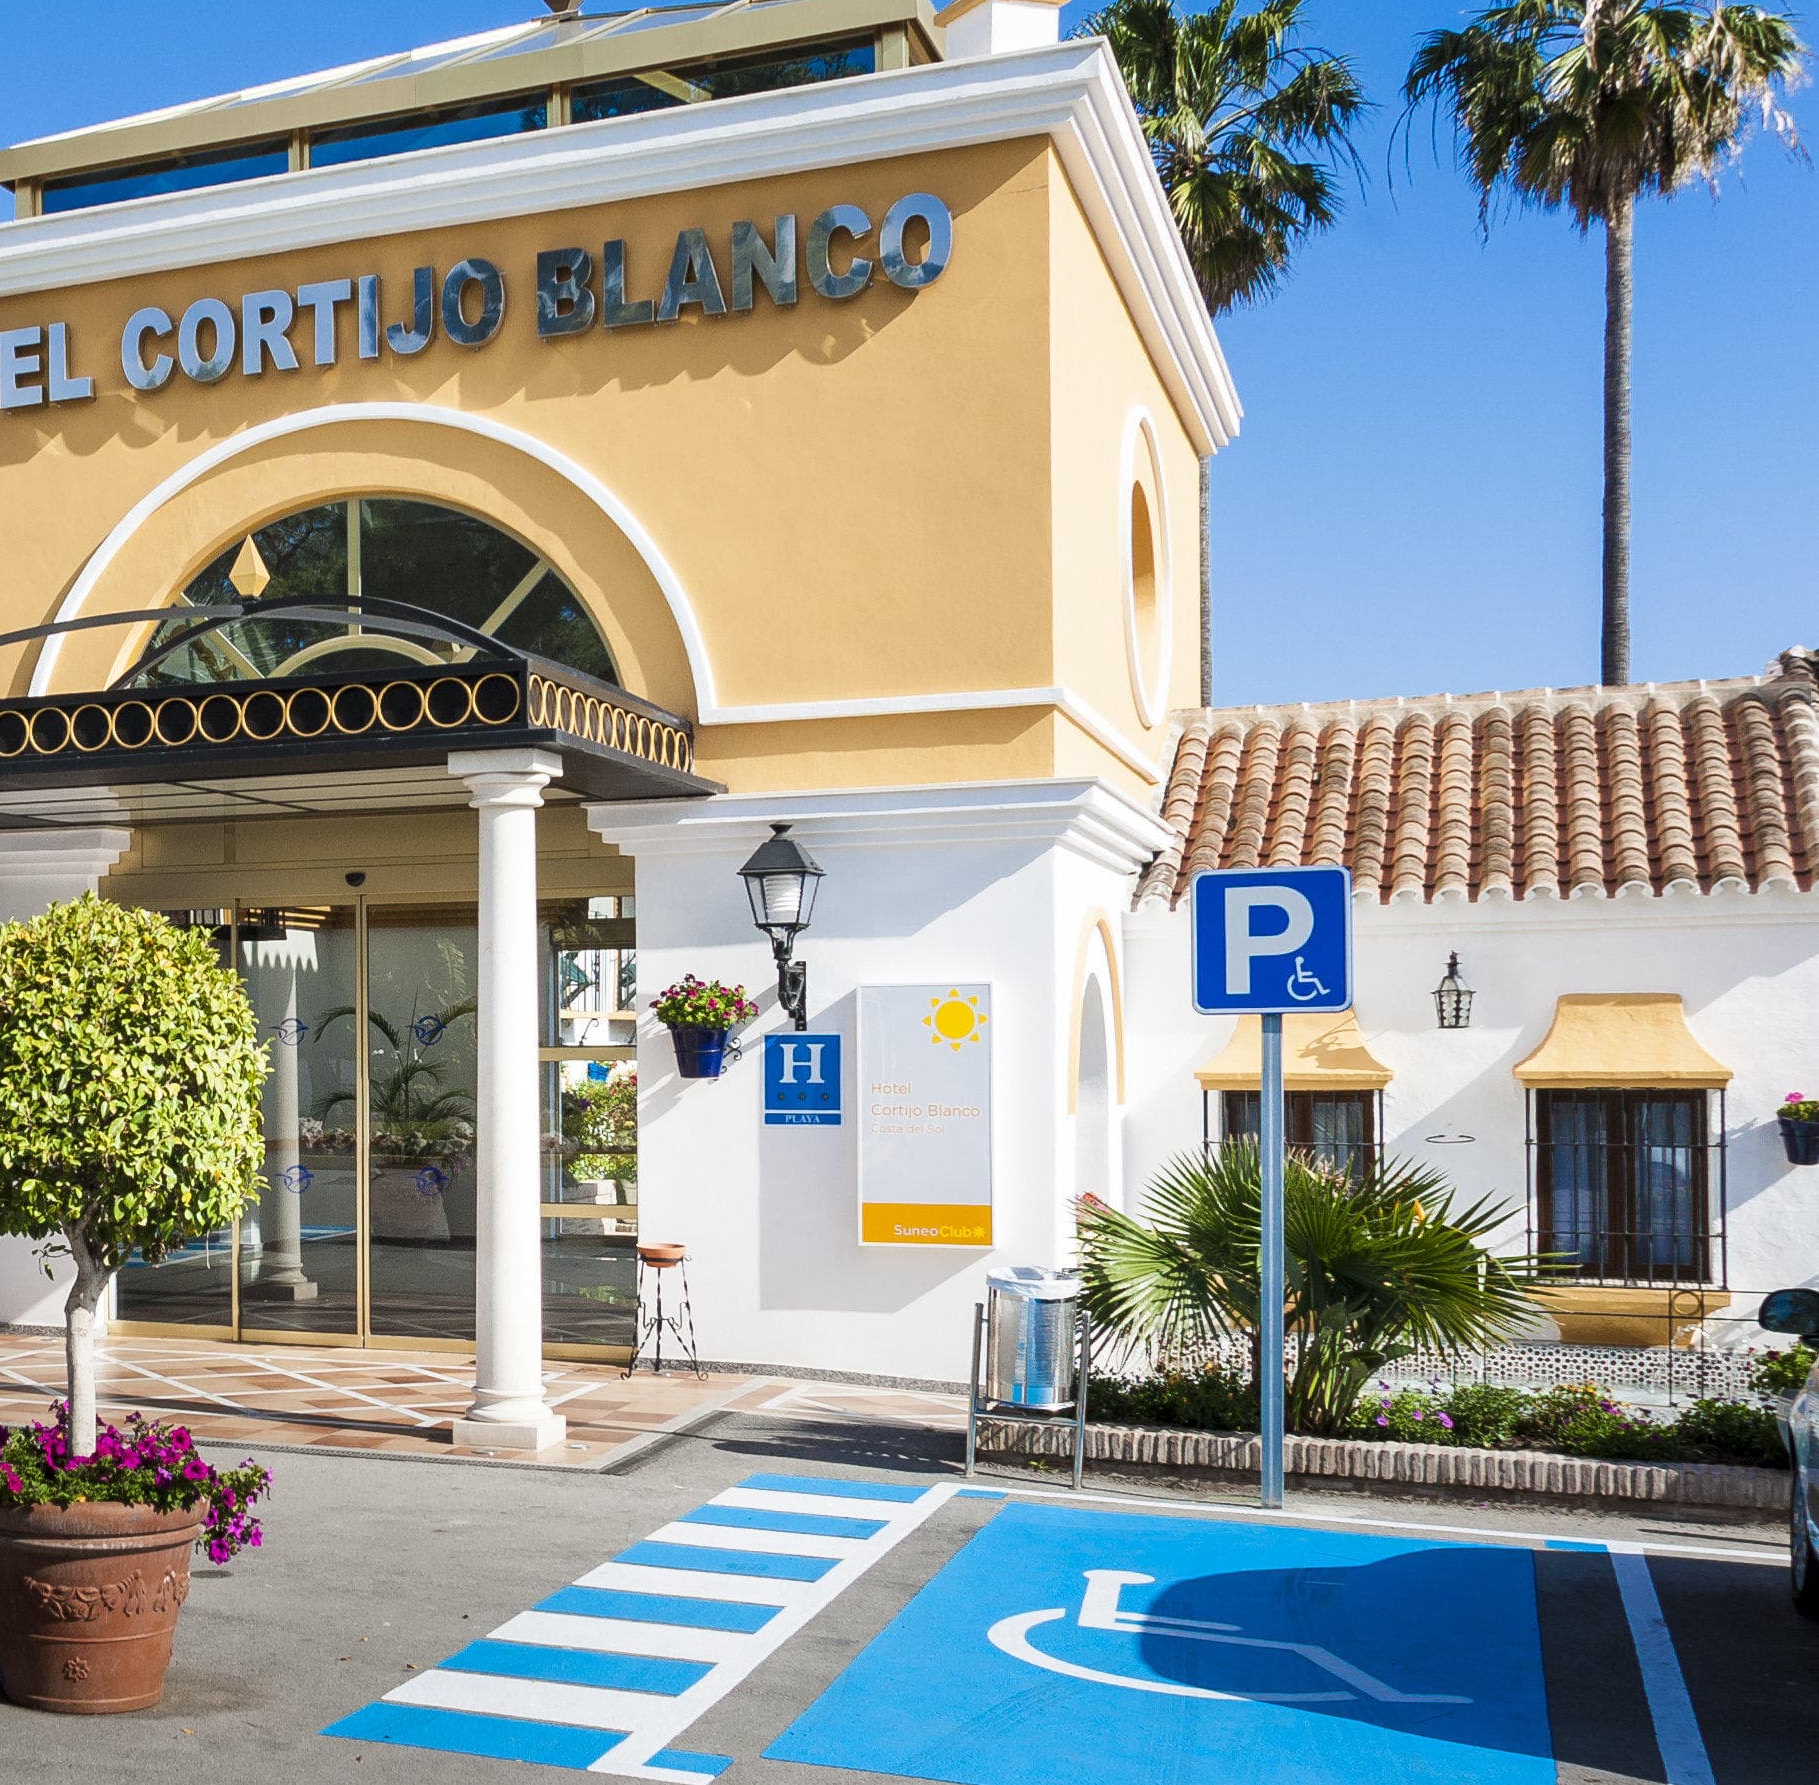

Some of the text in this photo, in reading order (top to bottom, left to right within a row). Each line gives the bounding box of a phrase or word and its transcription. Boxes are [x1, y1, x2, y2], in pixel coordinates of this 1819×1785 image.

[121, 257, 507, 390] CORTIJO
[536, 192, 954, 338] BLANCO
[1224, 885, 1315, 995] P
[778, 1043, 826, 1084] H
[871, 1082, 912, 1095] Hotel
[871, 1103, 981, 1118] Cortijo Blanco
[785, 1114, 821, 1123] PLAYA
[870, 1124, 945, 1134] Costa del Sol
